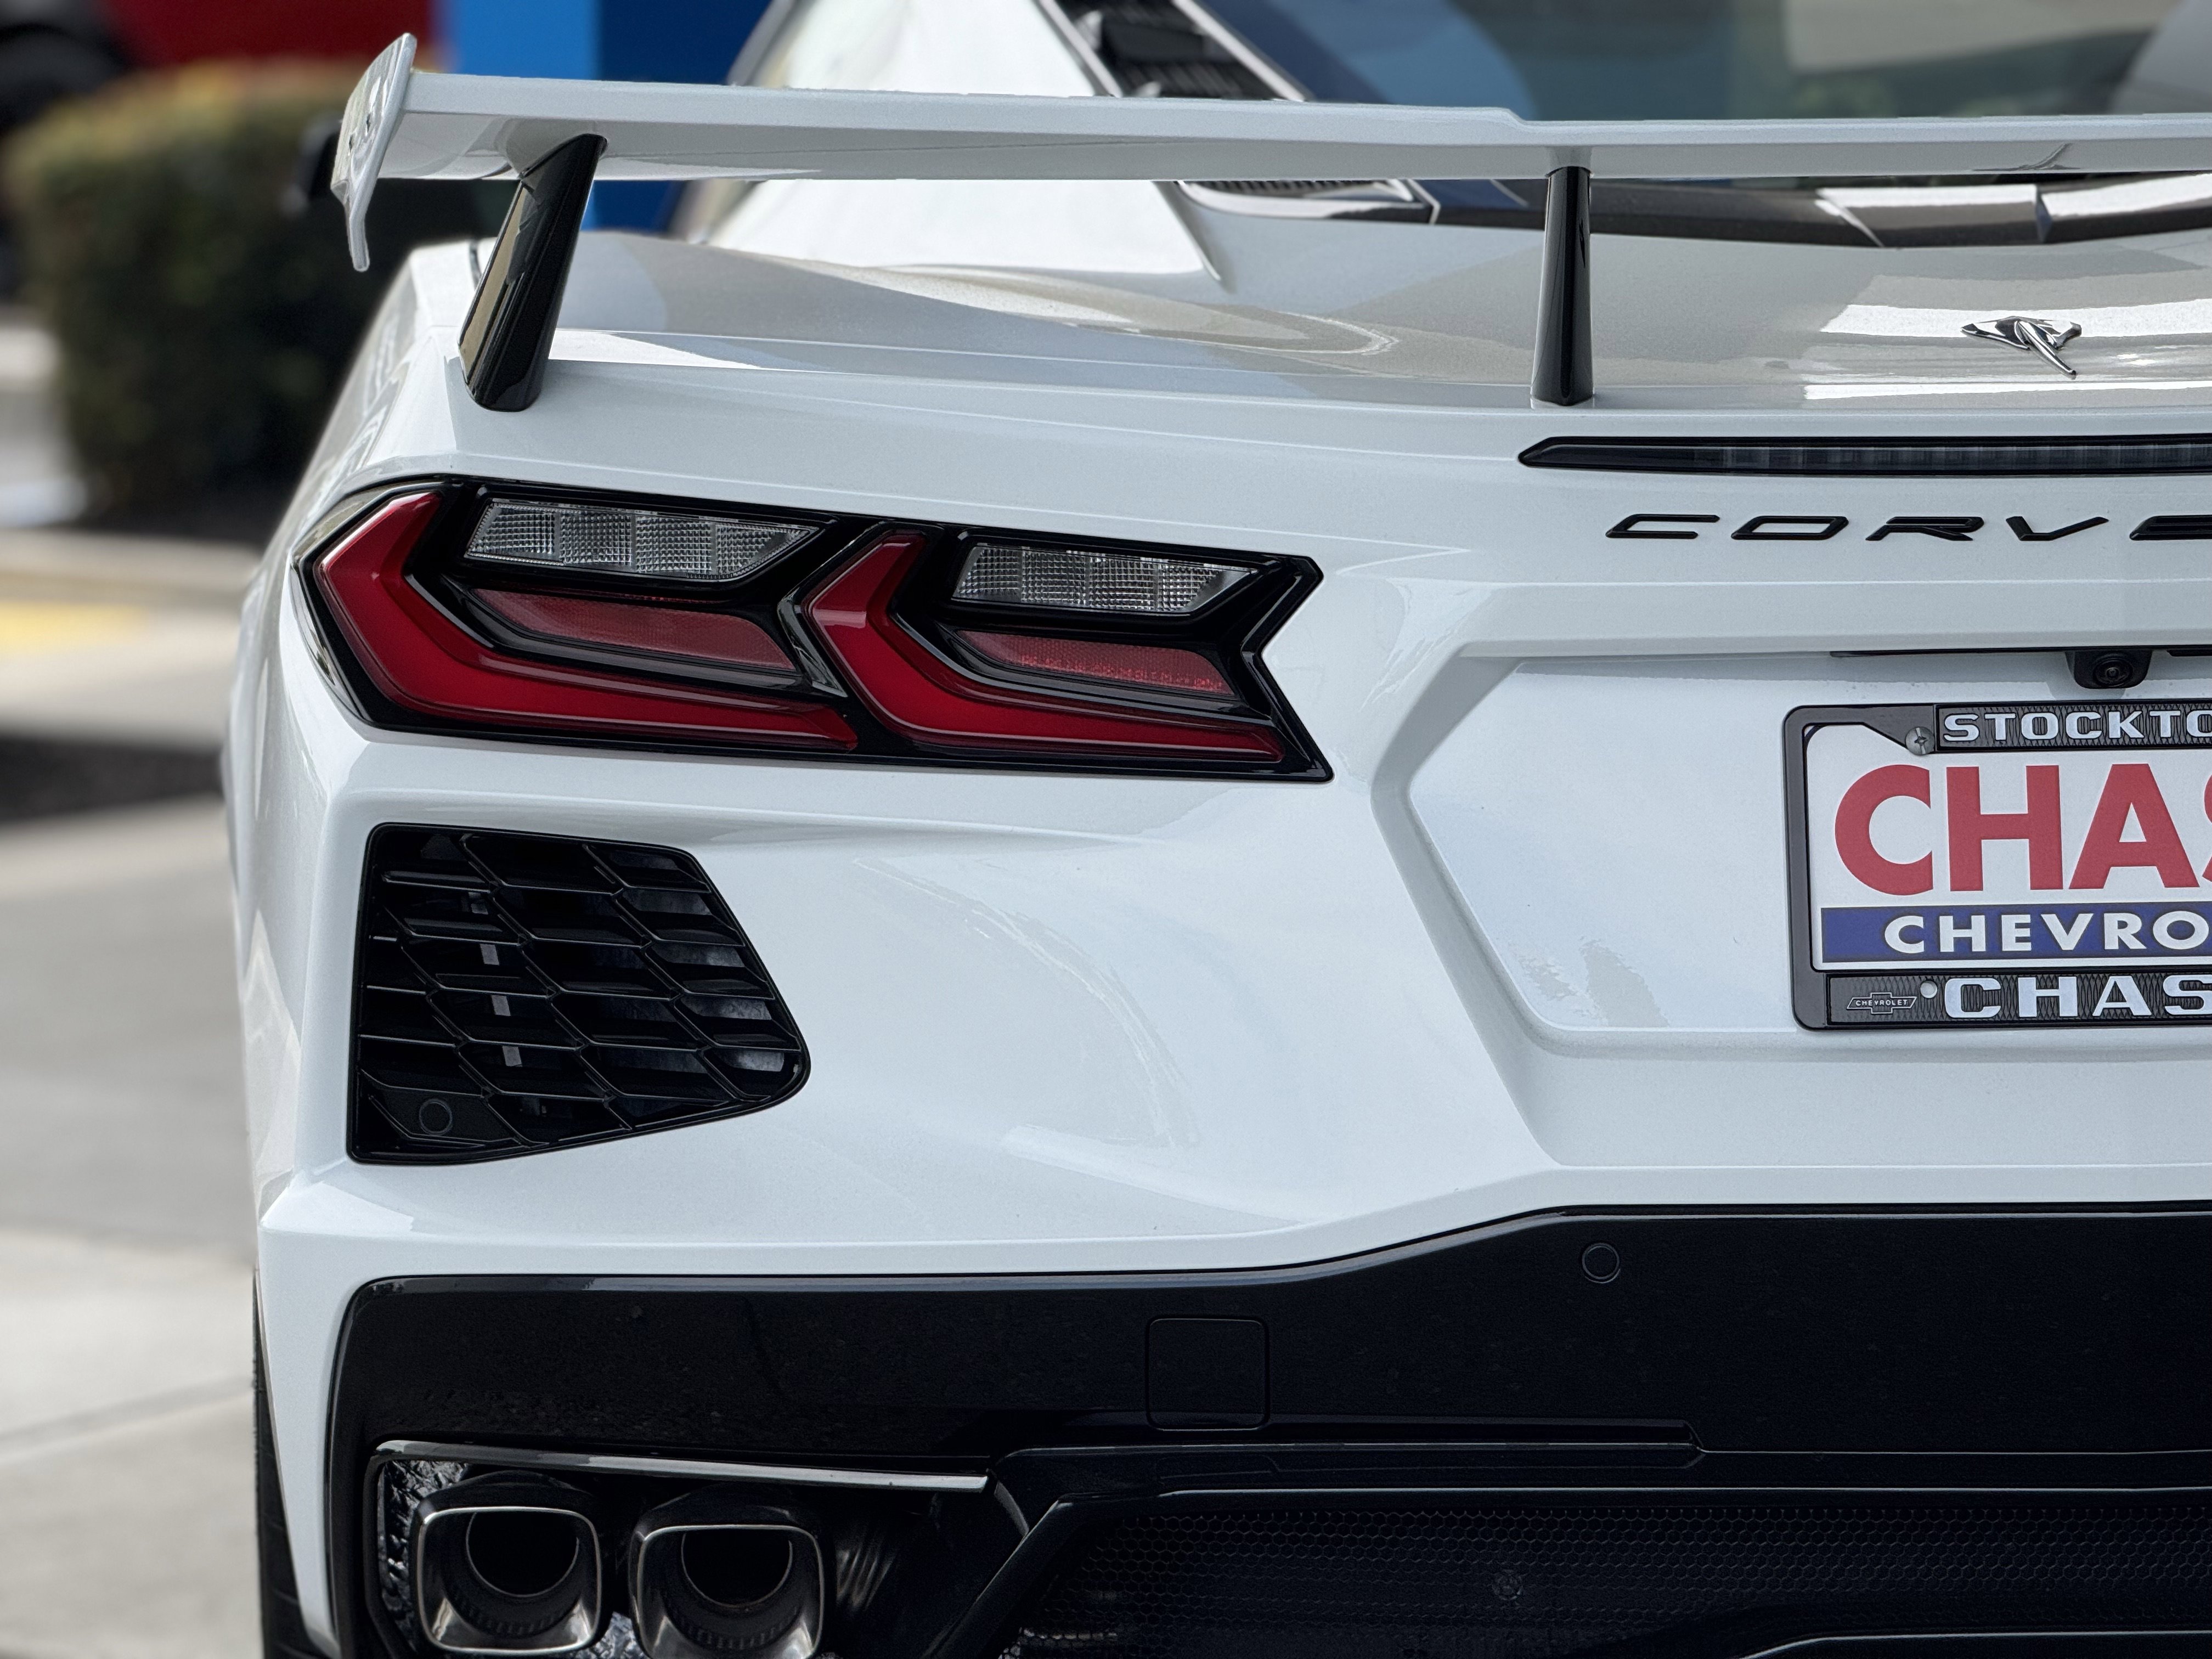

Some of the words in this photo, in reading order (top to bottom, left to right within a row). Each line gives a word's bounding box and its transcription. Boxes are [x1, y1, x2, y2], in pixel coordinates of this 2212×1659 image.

[1835, 763, 2212, 896] CHA
[1884, 910, 2210, 954] CHEVRO
[1944, 973, 2212, 1019] CHAS
